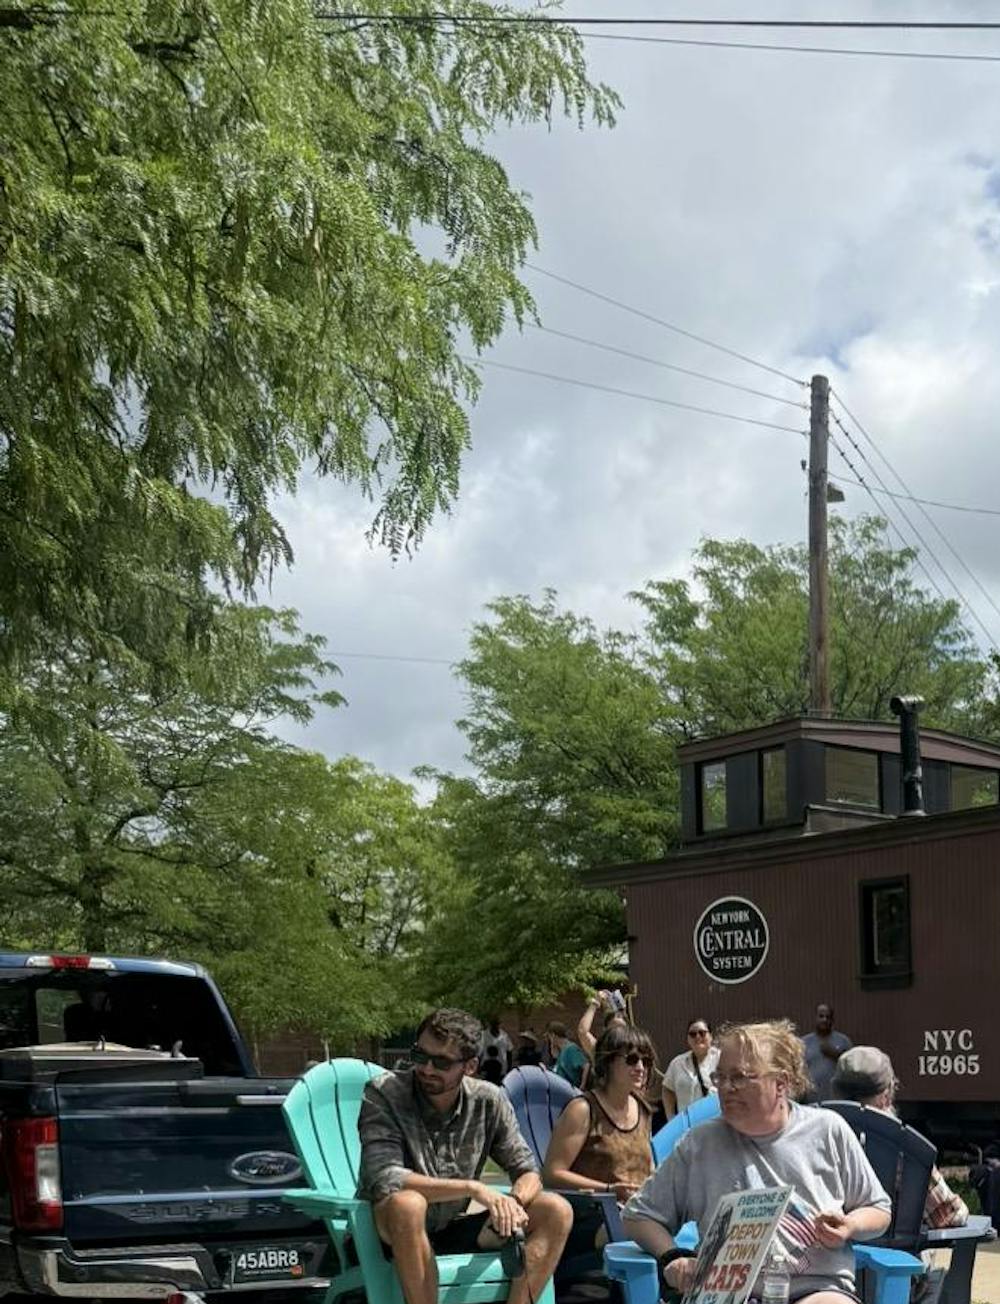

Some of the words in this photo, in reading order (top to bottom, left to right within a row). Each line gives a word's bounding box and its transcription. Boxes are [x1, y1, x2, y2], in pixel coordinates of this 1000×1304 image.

[701, 926, 765, 957] CENTRAL
[712, 955, 752, 969] SYSTEM
[924, 1029, 974, 1051] NYC
[738, 1192, 778, 1206] EVERYONE
[779, 1190, 787, 1202] IS
[741, 1205, 778, 1218] WELCOME
[729, 1222, 770, 1240] DEPOT
[237, 1250, 299, 1269] 45ABR8
[724, 1244, 760, 1261] TOWN
[704, 1264, 752, 1292] CATS
